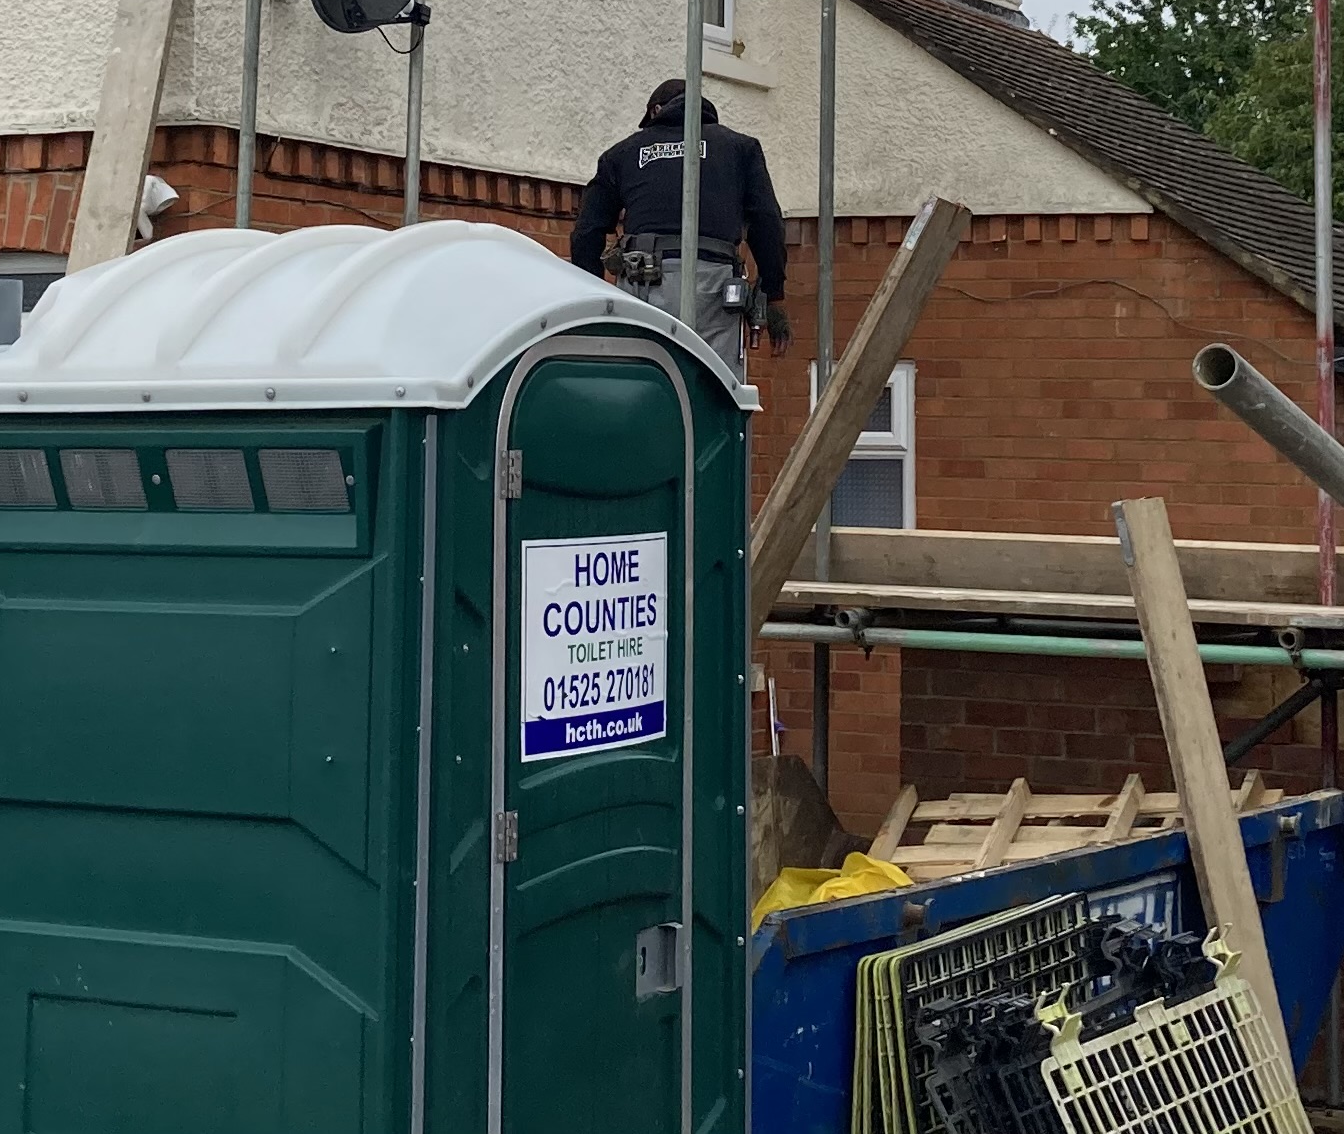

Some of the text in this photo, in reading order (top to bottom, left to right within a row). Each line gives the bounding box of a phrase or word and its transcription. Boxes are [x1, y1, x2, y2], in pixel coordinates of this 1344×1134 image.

[575, 549, 639, 588] HOME
[543, 593, 657, 637] COUNTIES
[567, 636, 643, 664] TOILET HIRE
[543, 663, 655, 712] 01525 270181
[565, 712, 643, 744] hcth.co.uk
